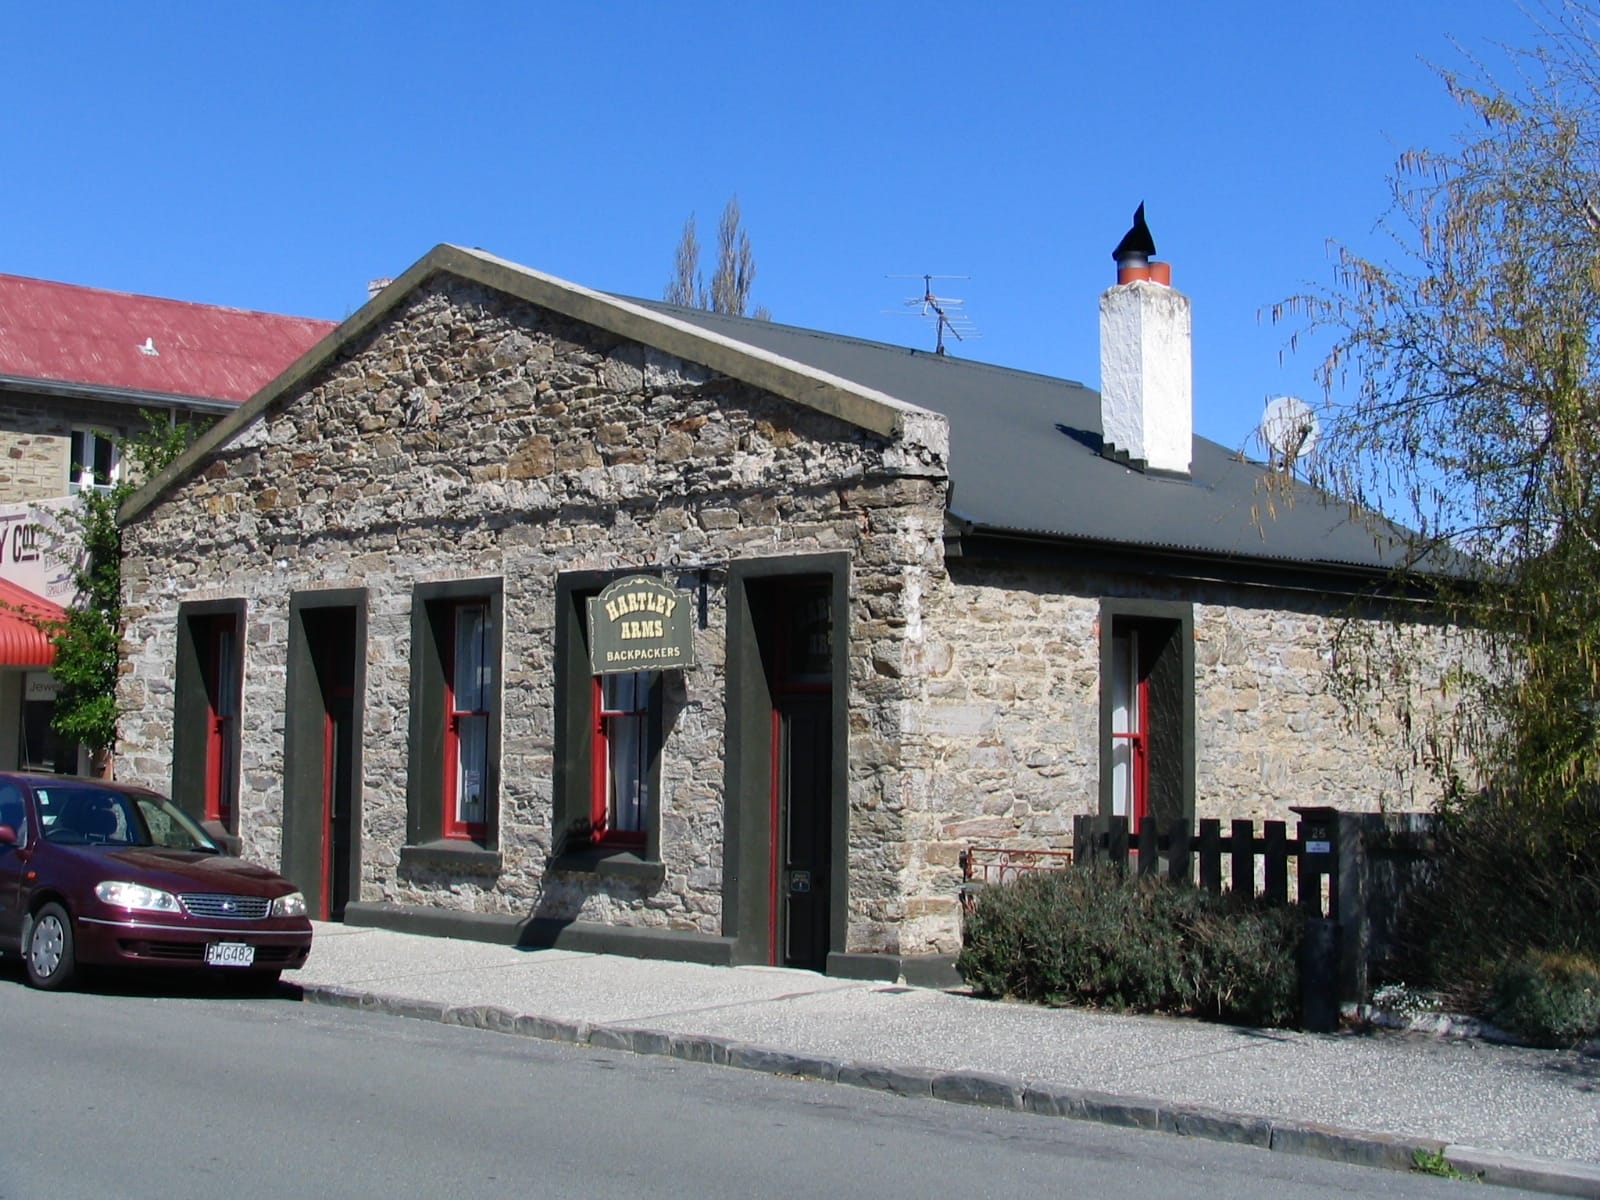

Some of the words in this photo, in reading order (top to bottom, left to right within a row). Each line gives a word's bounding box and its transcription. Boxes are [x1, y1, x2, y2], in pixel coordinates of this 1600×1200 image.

[605, 592, 676, 622] HARTLEY
[621, 620, 663, 640] ARMS
[606, 646, 680, 662] BACKPACKERS
